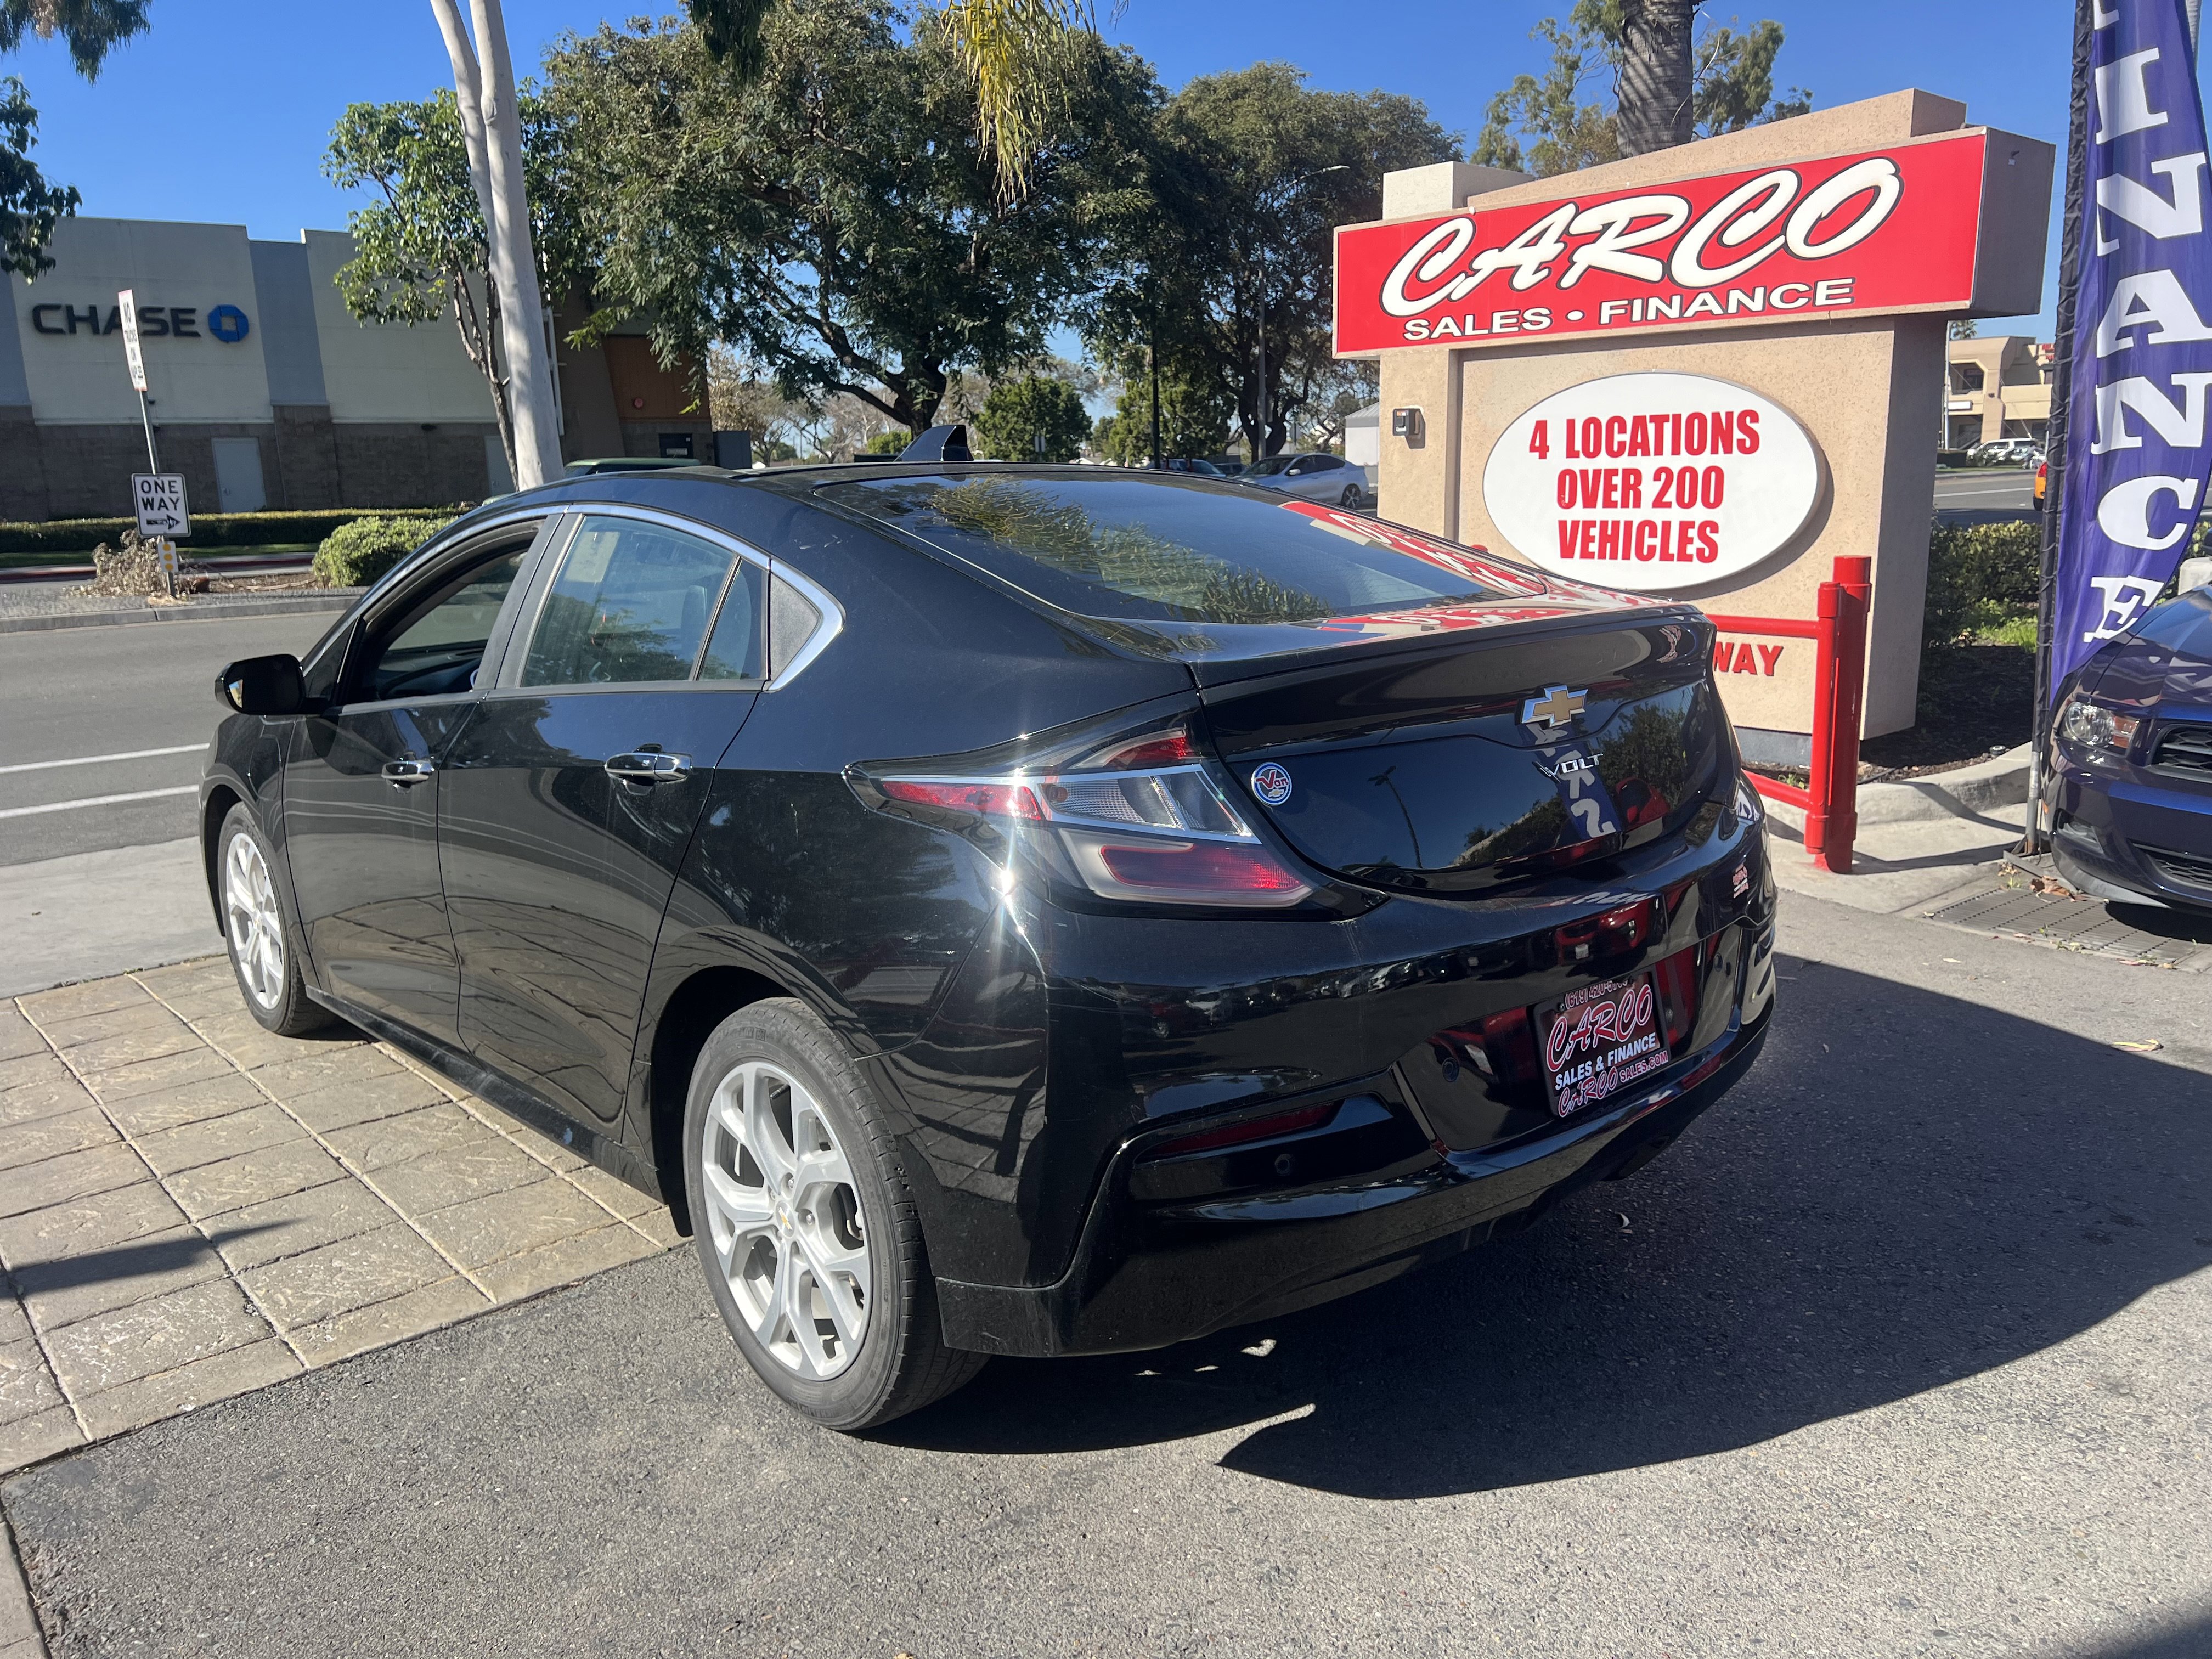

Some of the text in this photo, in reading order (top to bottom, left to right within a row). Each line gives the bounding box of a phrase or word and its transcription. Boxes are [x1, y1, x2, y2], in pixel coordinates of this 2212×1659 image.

[1379, 157, 1904, 318] CARCO
[1403, 277, 1856, 341] SALES FINANCE
[2083, 0, 2212, 642] INANCE
[1529, 409, 1760, 459] 4 LOCATIONS
[140, 479, 178, 494] ONE
[141, 496, 180, 511] WAY
[1557, 466, 1724, 509] OVER 200
[1558, 520, 1719, 563] VEHICLES
[1254, 769, 1290, 790] Van
[1533, 753, 1603, 783] VOLT
[1565, 988, 1588, 1009] (619)
[1546, 984, 1652, 1072] CARCO
[1555, 1032, 1656, 1091] SALES & FINANCE
[1558, 1050, 1669, 1118] CARCO SALES.COM
